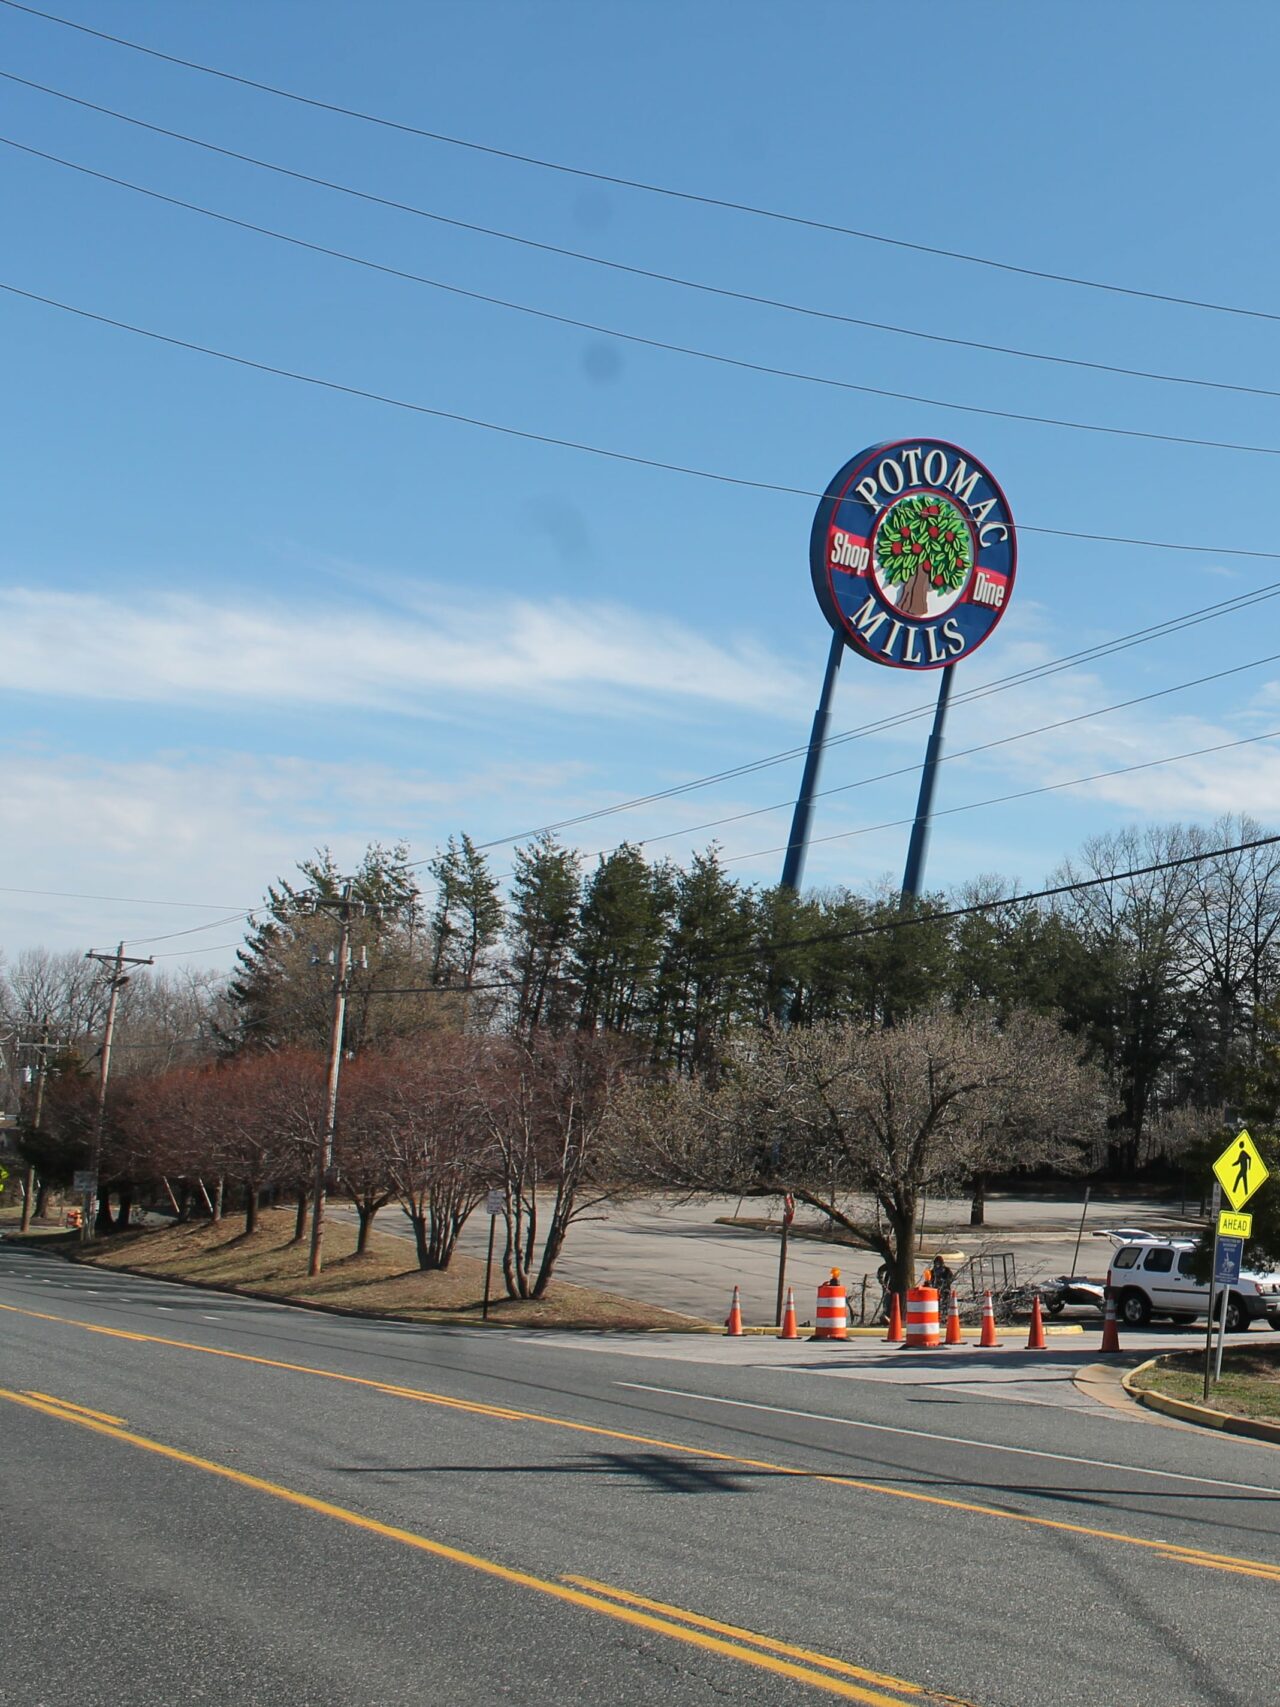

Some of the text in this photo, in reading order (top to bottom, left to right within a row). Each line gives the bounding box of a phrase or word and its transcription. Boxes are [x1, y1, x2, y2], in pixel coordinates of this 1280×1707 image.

[855, 446, 1009, 548] POTOMAC
[831, 532, 870, 575] Shop
[972, 572, 1005, 608] Dine
[848, 594, 966, 663] MILLS
[1222, 1218, 1248, 1232] AHEAD
